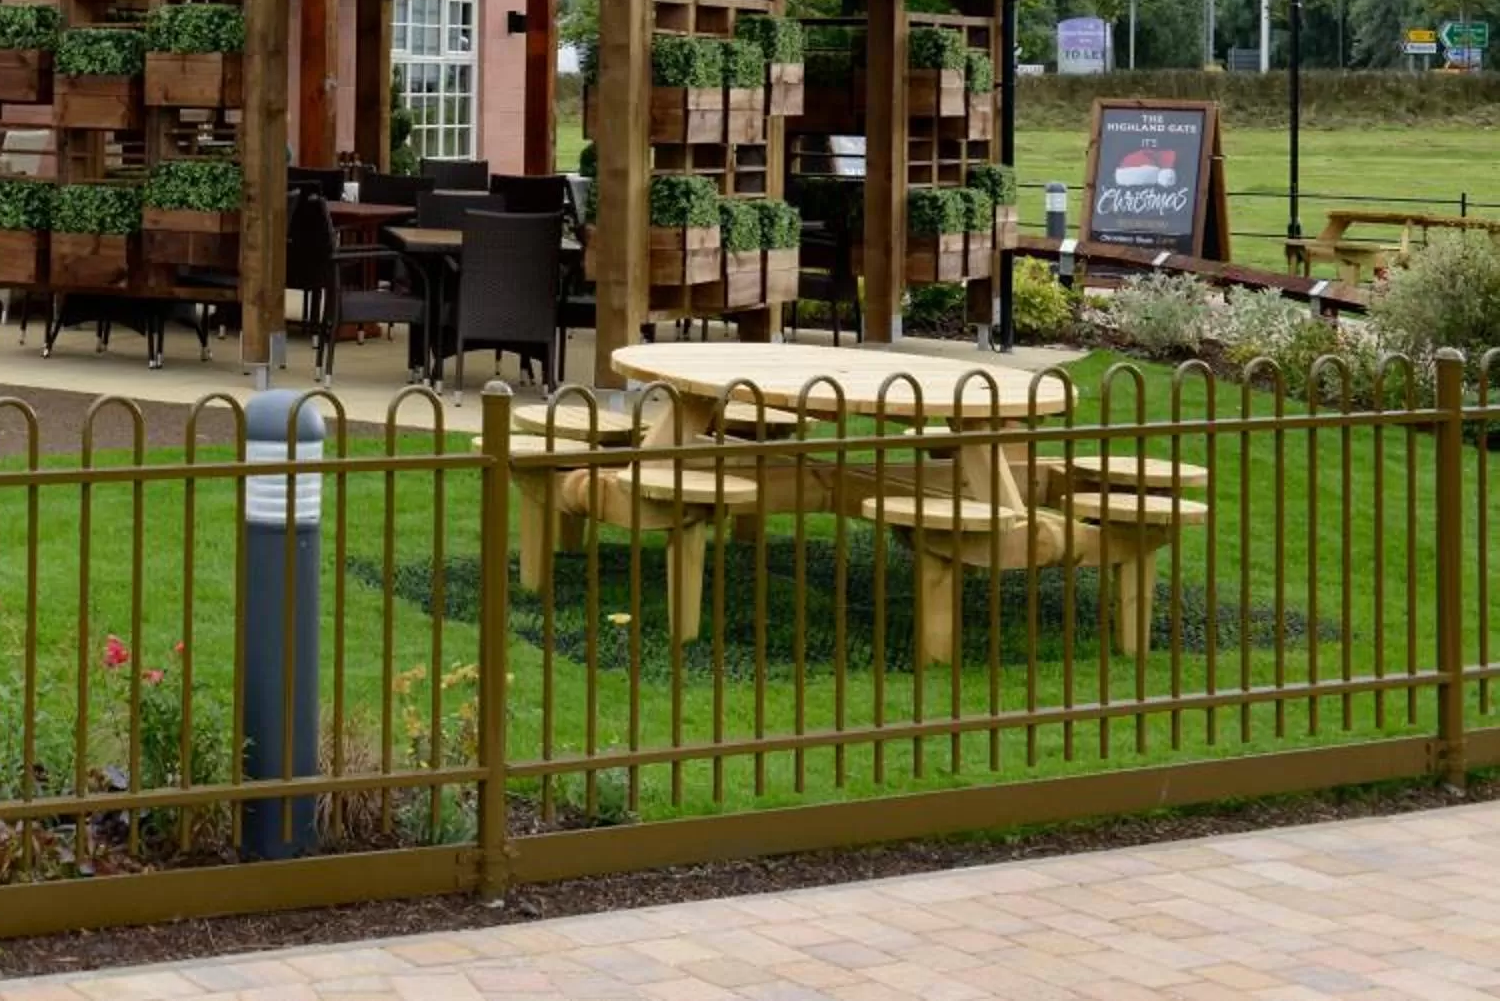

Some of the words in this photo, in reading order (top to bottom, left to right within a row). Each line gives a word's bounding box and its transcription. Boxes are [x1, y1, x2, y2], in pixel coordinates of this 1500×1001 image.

[1141, 114, 1164, 123] THE
[1107, 122, 1165, 132] HIGHLAND
[1167, 124, 1197, 134] GATE
[1097, 186, 1189, 215] Christmas
